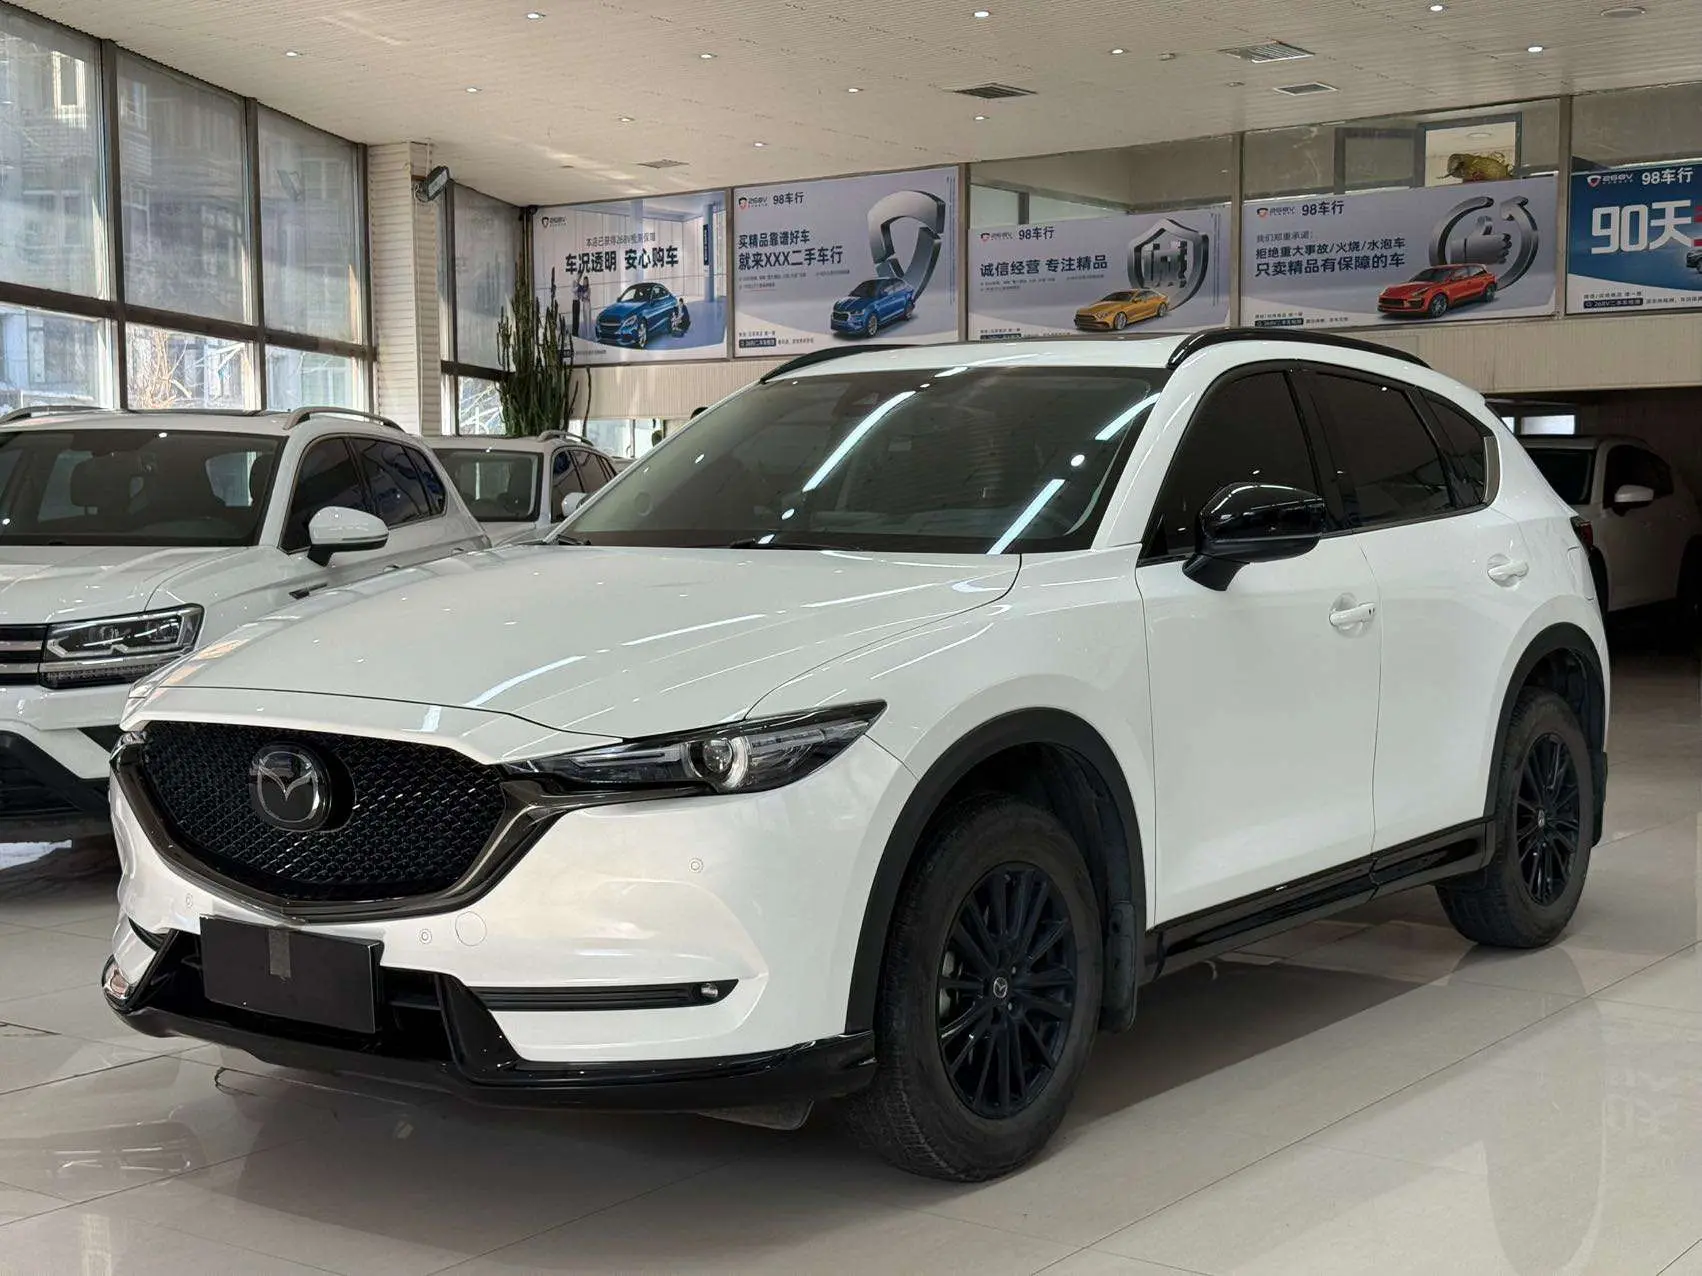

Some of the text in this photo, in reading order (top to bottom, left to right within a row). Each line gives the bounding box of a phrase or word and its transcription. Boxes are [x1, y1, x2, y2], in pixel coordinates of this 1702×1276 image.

[1641, 167, 1694, 186] 98车行
[773, 191, 804, 205] 98车行
[1302, 200, 1344, 216] 98车行
[1018, 226, 1055, 240] 98车行
[1591, 199, 1702, 255] 90天
[738, 229, 810, 250] 买精品靠谱好车
[1255, 237, 1406, 260] 拒绝重大事故/火烧/水泡车
[565, 245, 679, 275] 车况透明 安心购车
[738, 245, 843, 271] 就来XXX二手车行
[979, 254, 1108, 277] 诚信经营 专注精品
[1255, 252, 1405, 277] 只卖精品有保障的车
